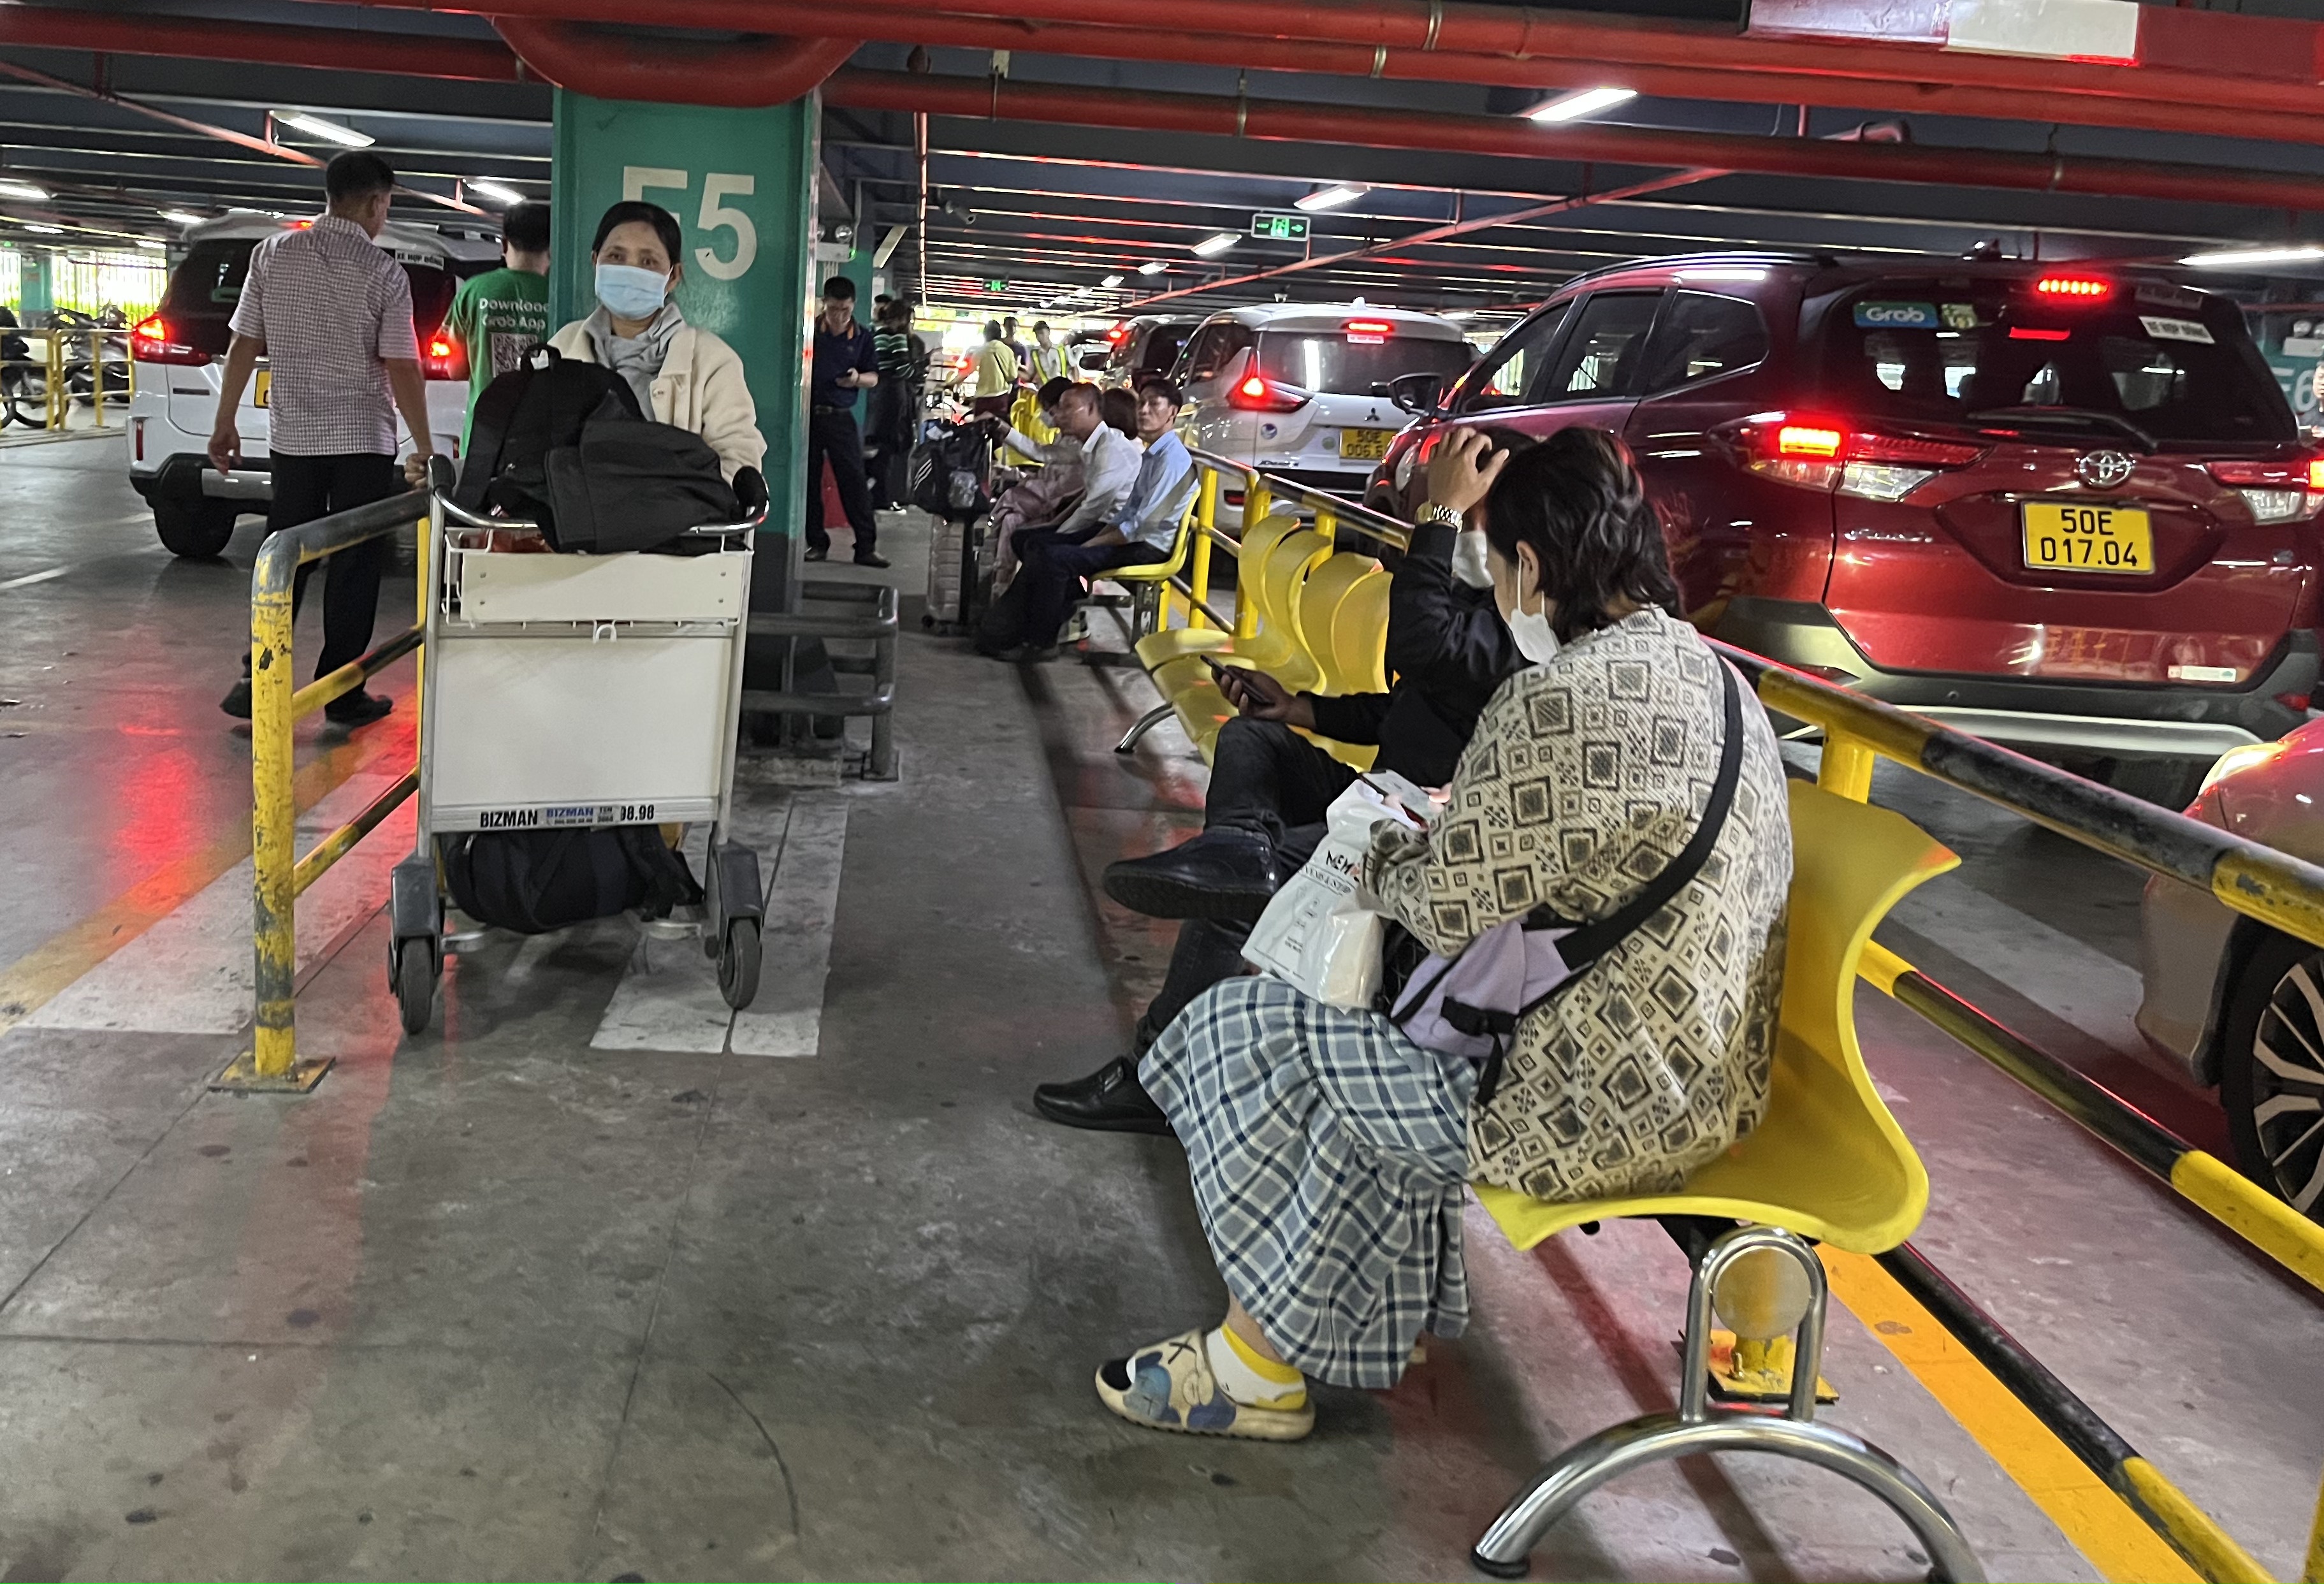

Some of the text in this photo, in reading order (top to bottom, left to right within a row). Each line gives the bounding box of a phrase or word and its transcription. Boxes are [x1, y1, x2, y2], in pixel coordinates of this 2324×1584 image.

[1866, 307, 1926, 323] Grab
[2060, 509, 2114, 535] 50E
[2040, 537, 2137, 567] 017.04
[480, 810, 538, 828] BIZMAN
[546, 807, 593, 818] BIZMAN
